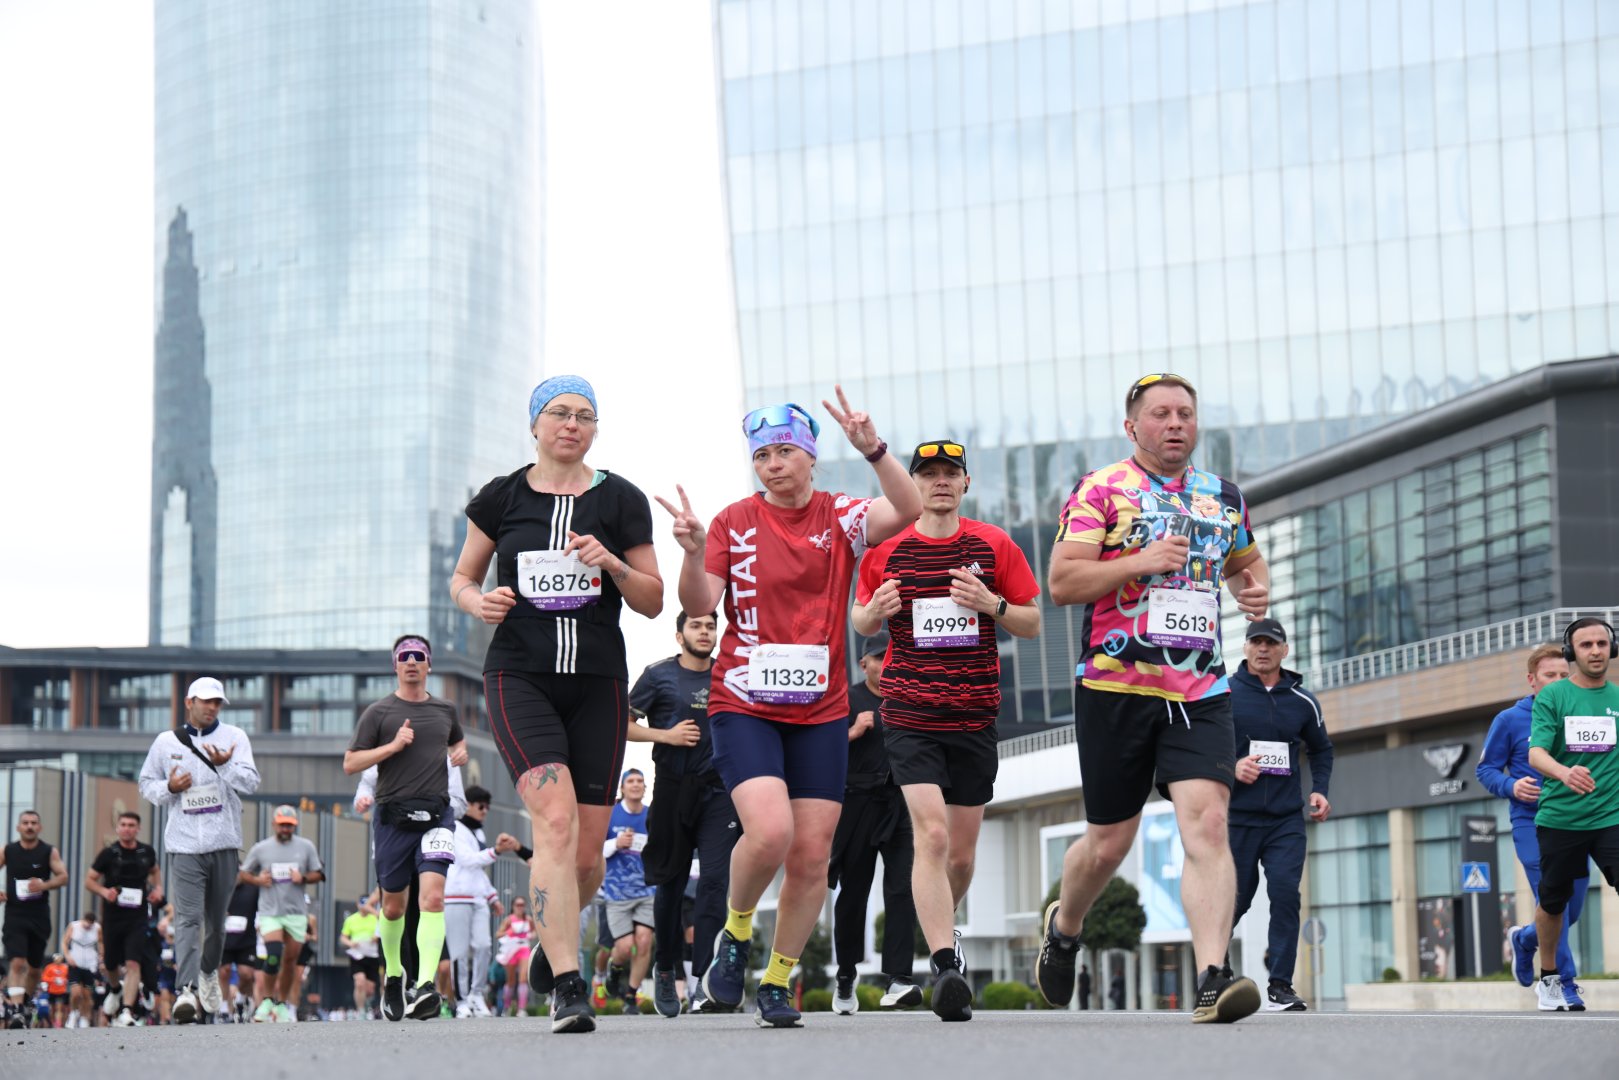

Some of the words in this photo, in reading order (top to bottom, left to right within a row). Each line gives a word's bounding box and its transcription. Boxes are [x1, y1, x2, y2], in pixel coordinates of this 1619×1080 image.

[529, 573, 590, 592] 16876
[923, 617, 967, 632] 4999
[1165, 613, 1207, 632] 5613
[762, 668, 817, 686] 11332
[1576, 730, 1607, 742] 1867
[187, 796, 218, 807] 16896
